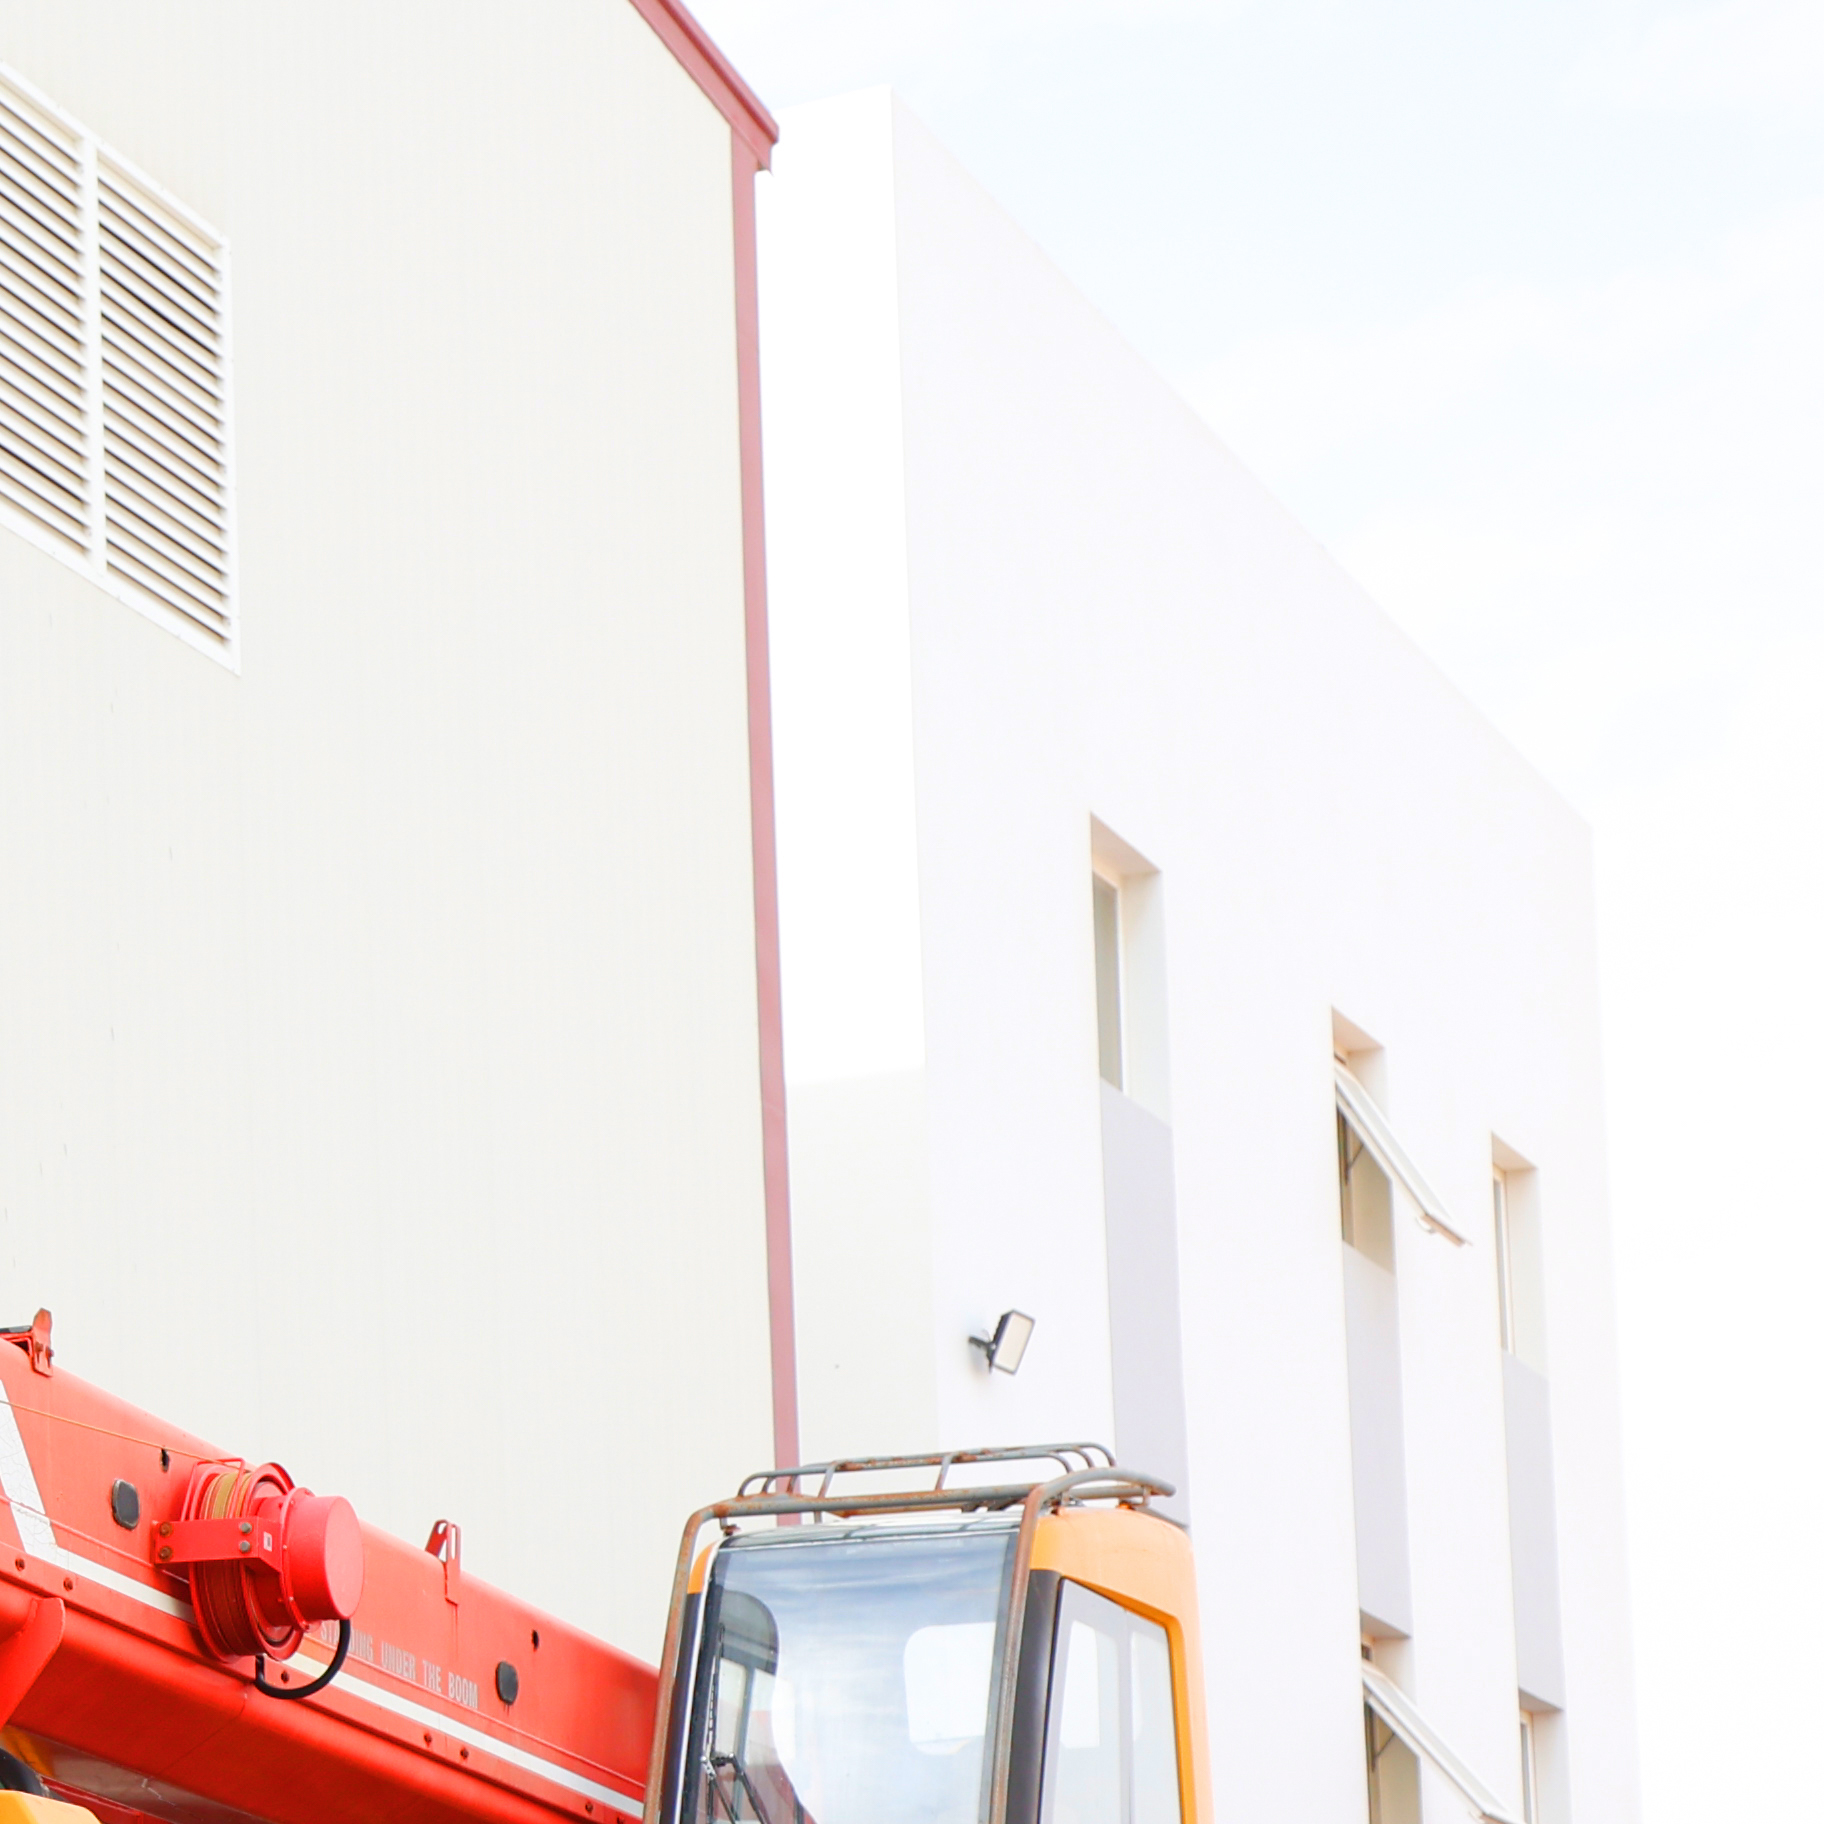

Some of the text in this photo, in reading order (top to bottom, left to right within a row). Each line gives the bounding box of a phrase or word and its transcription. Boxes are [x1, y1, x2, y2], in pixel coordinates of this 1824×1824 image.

[381, 1641, 417, 1680] UNDER
[423, 1659, 443, 1693] THE
[448, 1671, 479, 1709] BOOM
